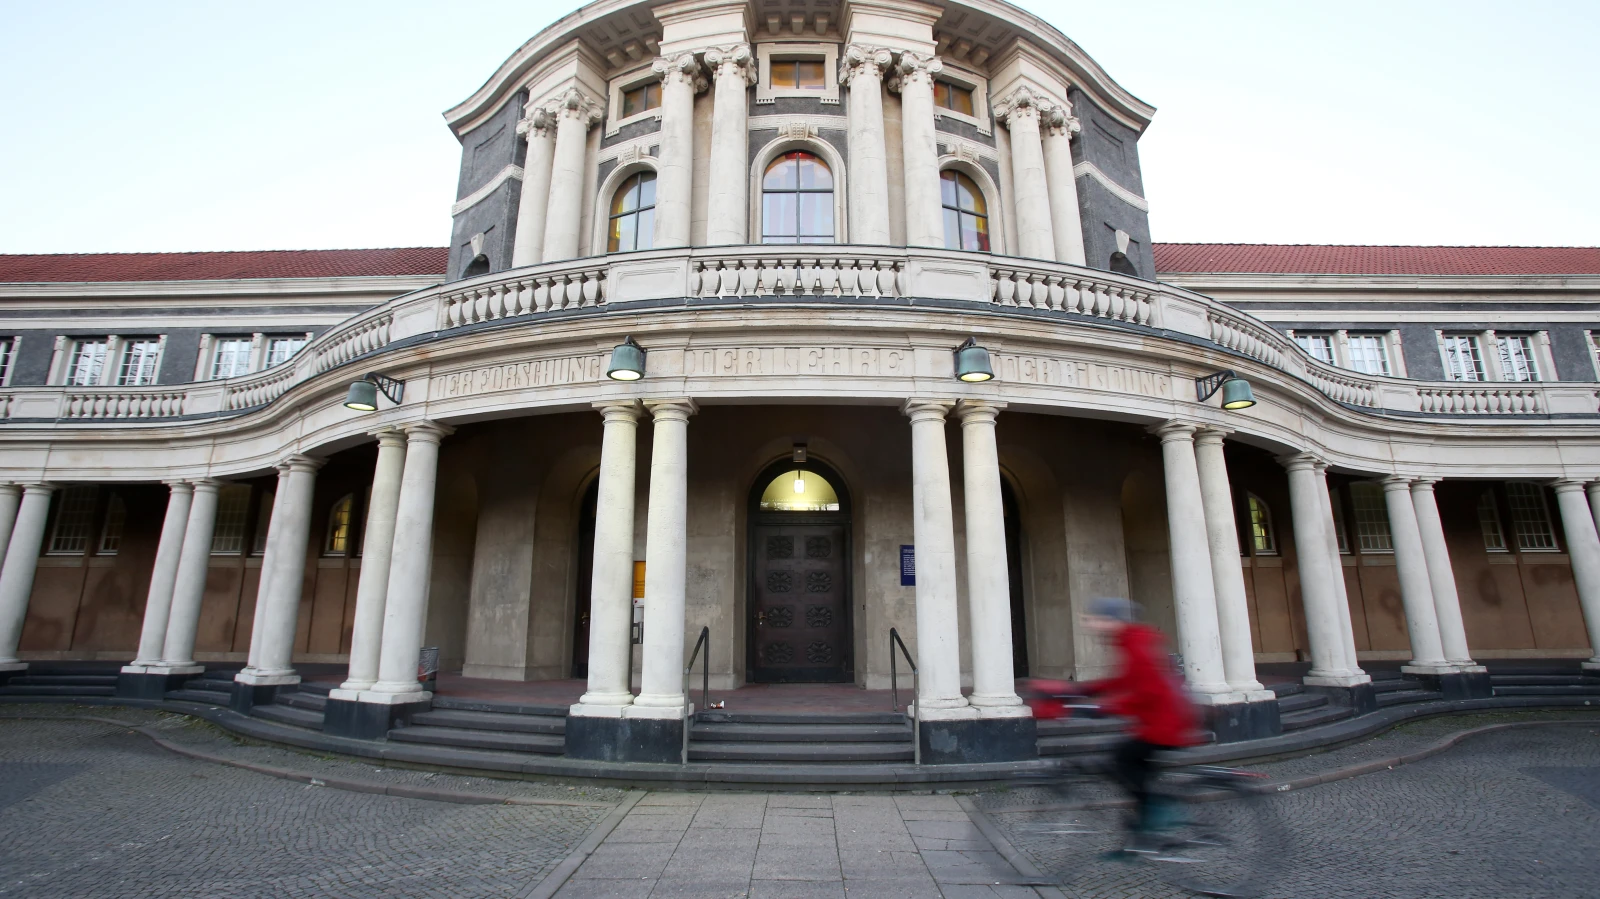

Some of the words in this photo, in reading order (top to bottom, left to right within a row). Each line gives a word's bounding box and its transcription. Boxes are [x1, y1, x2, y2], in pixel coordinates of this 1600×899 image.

[434, 371, 474, 398] DER
[477, 355, 601, 391] FORSCHUNG
[692, 349, 762, 374] DER
[774, 348, 906, 374] LEHRE
[1000, 355, 1053, 384] DER
[1059, 361, 1170, 397] BILDUNG
